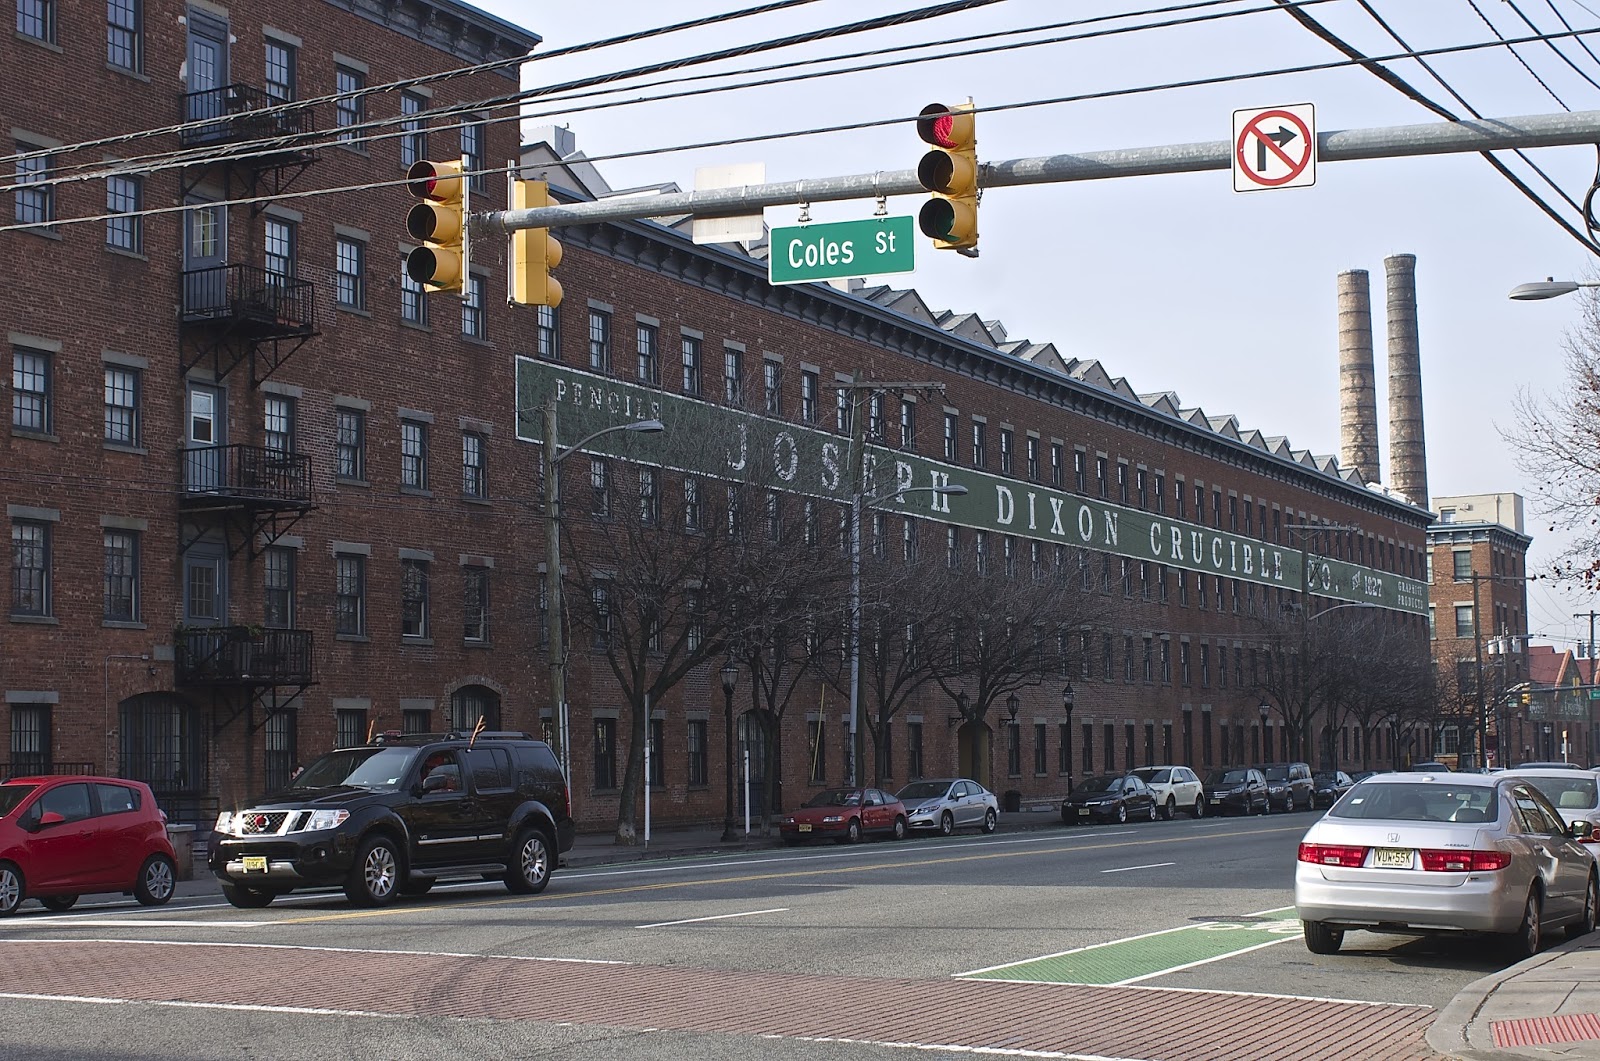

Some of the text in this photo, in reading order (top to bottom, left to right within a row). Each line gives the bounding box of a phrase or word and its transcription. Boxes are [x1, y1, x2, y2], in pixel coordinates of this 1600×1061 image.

[788, 231, 896, 269] Coles St
[727, 422, 951, 514] JOSEPH
[995, 484, 1118, 546] DIXON
[1150, 521, 1283, 580] CRUCIBLE
[1364, 575, 1383, 598] 1827
[1397, 580, 1423, 597] GRAPHITE
[1397, 594, 1424, 610] PRODUCTS
